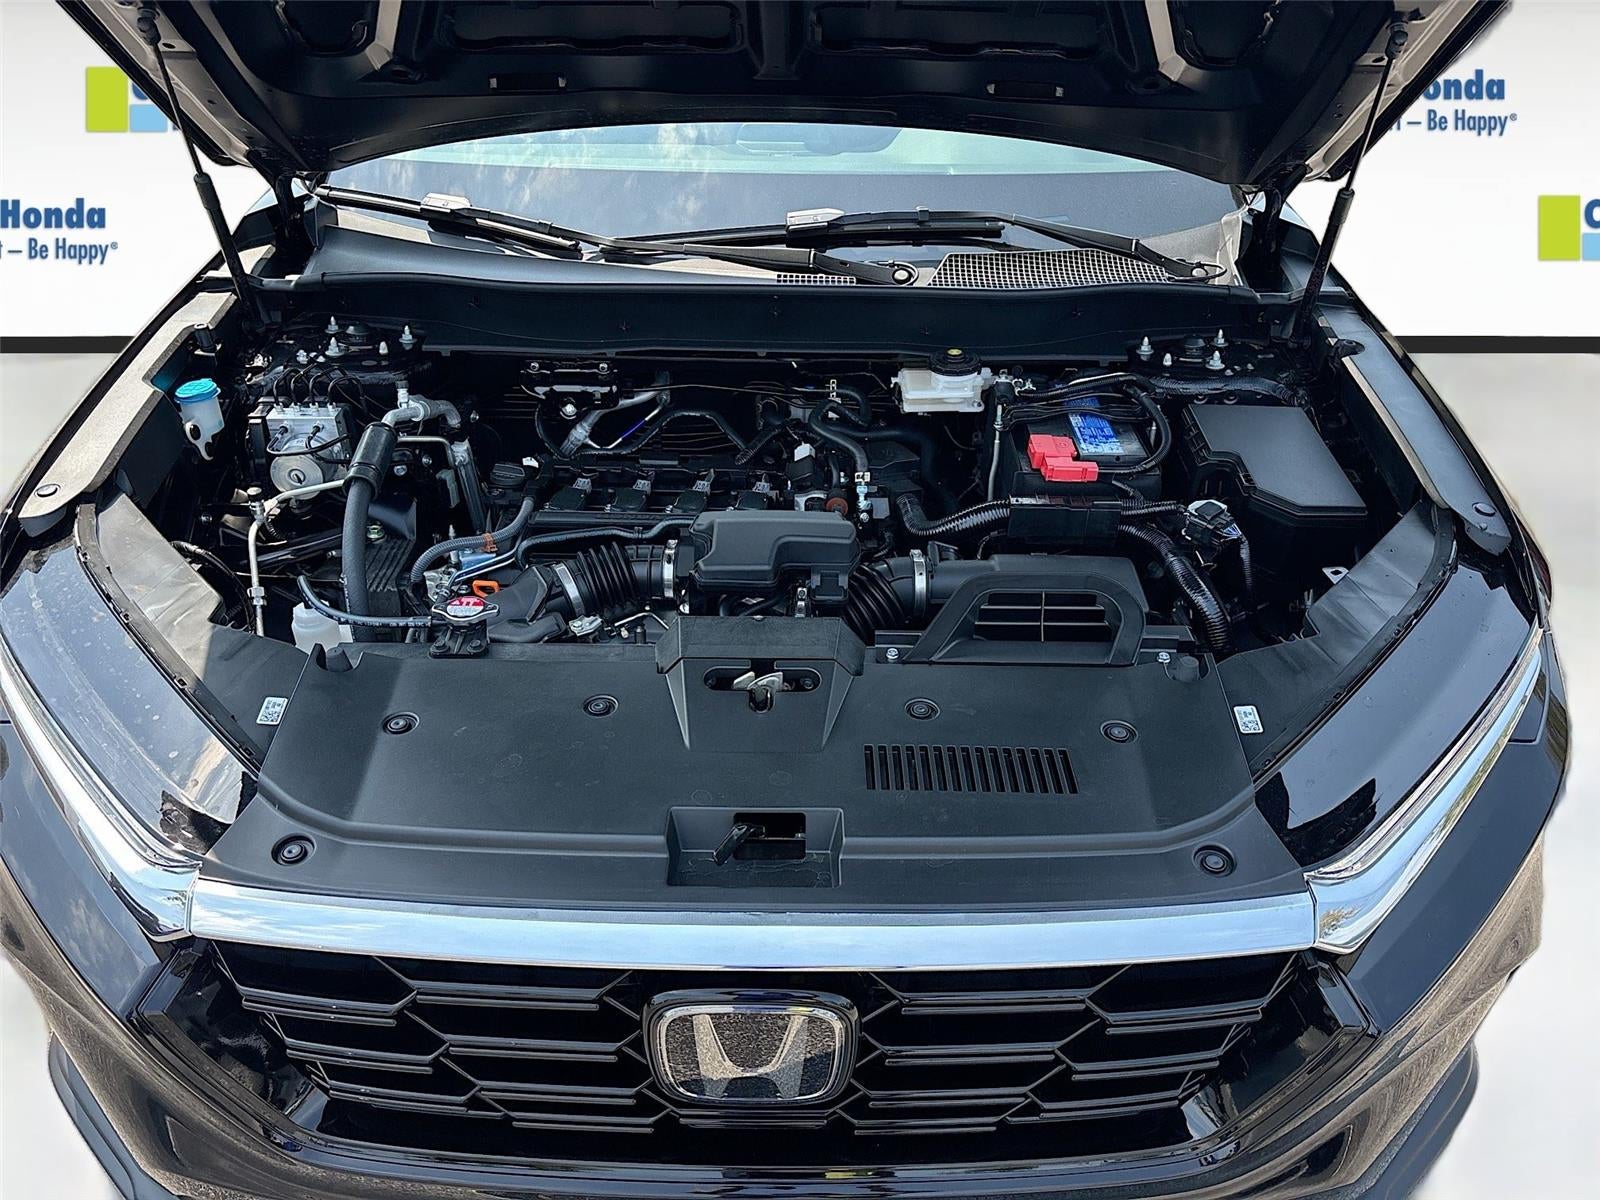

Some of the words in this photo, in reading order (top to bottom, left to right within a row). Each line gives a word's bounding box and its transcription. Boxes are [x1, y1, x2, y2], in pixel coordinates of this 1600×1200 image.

[1422, 69, 1505, 100] onda
[1427, 109, 1448, 131] Be
[0, 197, 106, 229] Honda
[28, 237, 49, 260] Be
